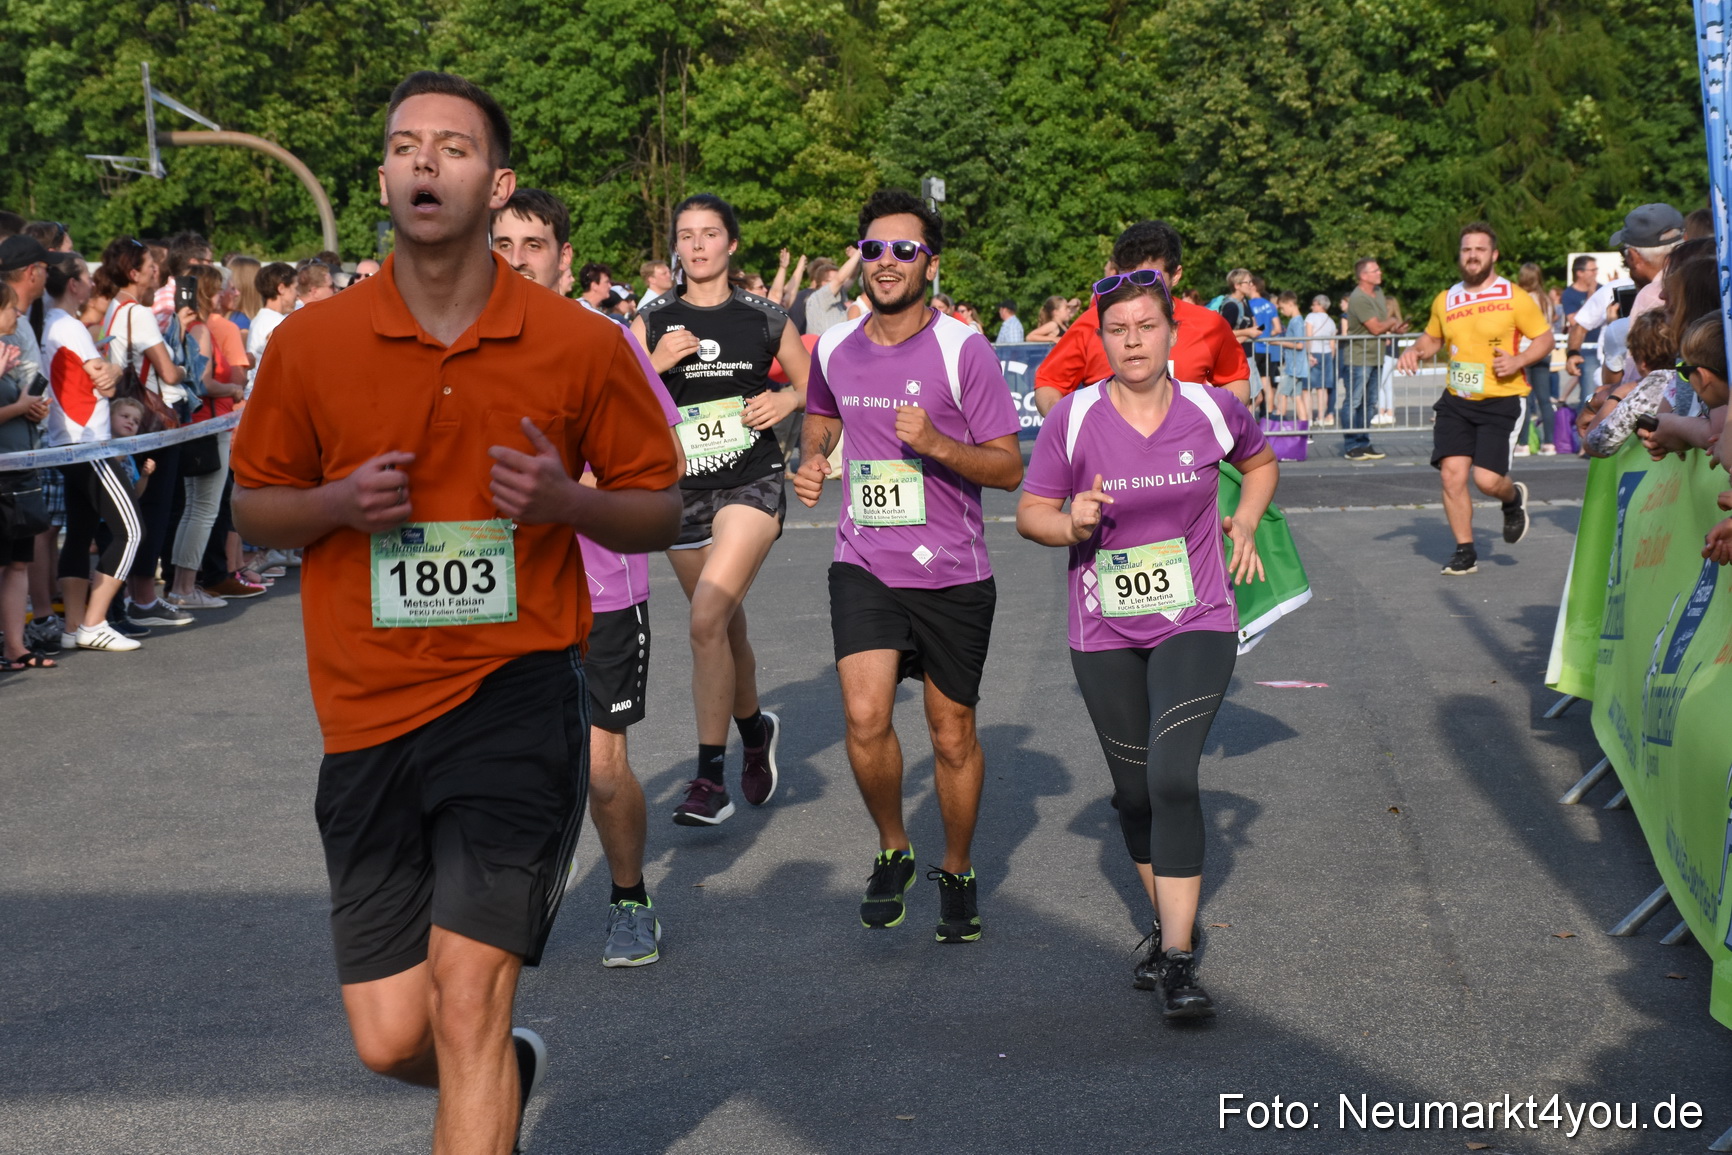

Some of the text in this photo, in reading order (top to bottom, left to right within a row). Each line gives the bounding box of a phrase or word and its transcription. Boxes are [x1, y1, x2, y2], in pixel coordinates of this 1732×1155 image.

[1446, 303, 1514, 323] MAX BÖGL
[684, 370, 734, 379] SCHOTTERWERKE
[1452, 371, 1479, 384] 1595
[841, 395, 860, 407] WIR
[862, 396, 890, 409] SIND
[697, 420, 725, 442] 94
[1102, 471, 1201, 491] WIR SIND LILA.
[862, 484, 901, 507] 881
[479, 547, 505, 557] 2019
[1165, 557, 1182, 566] 2019
[390, 558, 496, 596] 1803
[1115, 568, 1170, 598] 903
[403, 597, 485, 608] Metschl Fabian
[1146, 593, 1173, 603] Martina
[611, 699, 632, 713] JAKO
